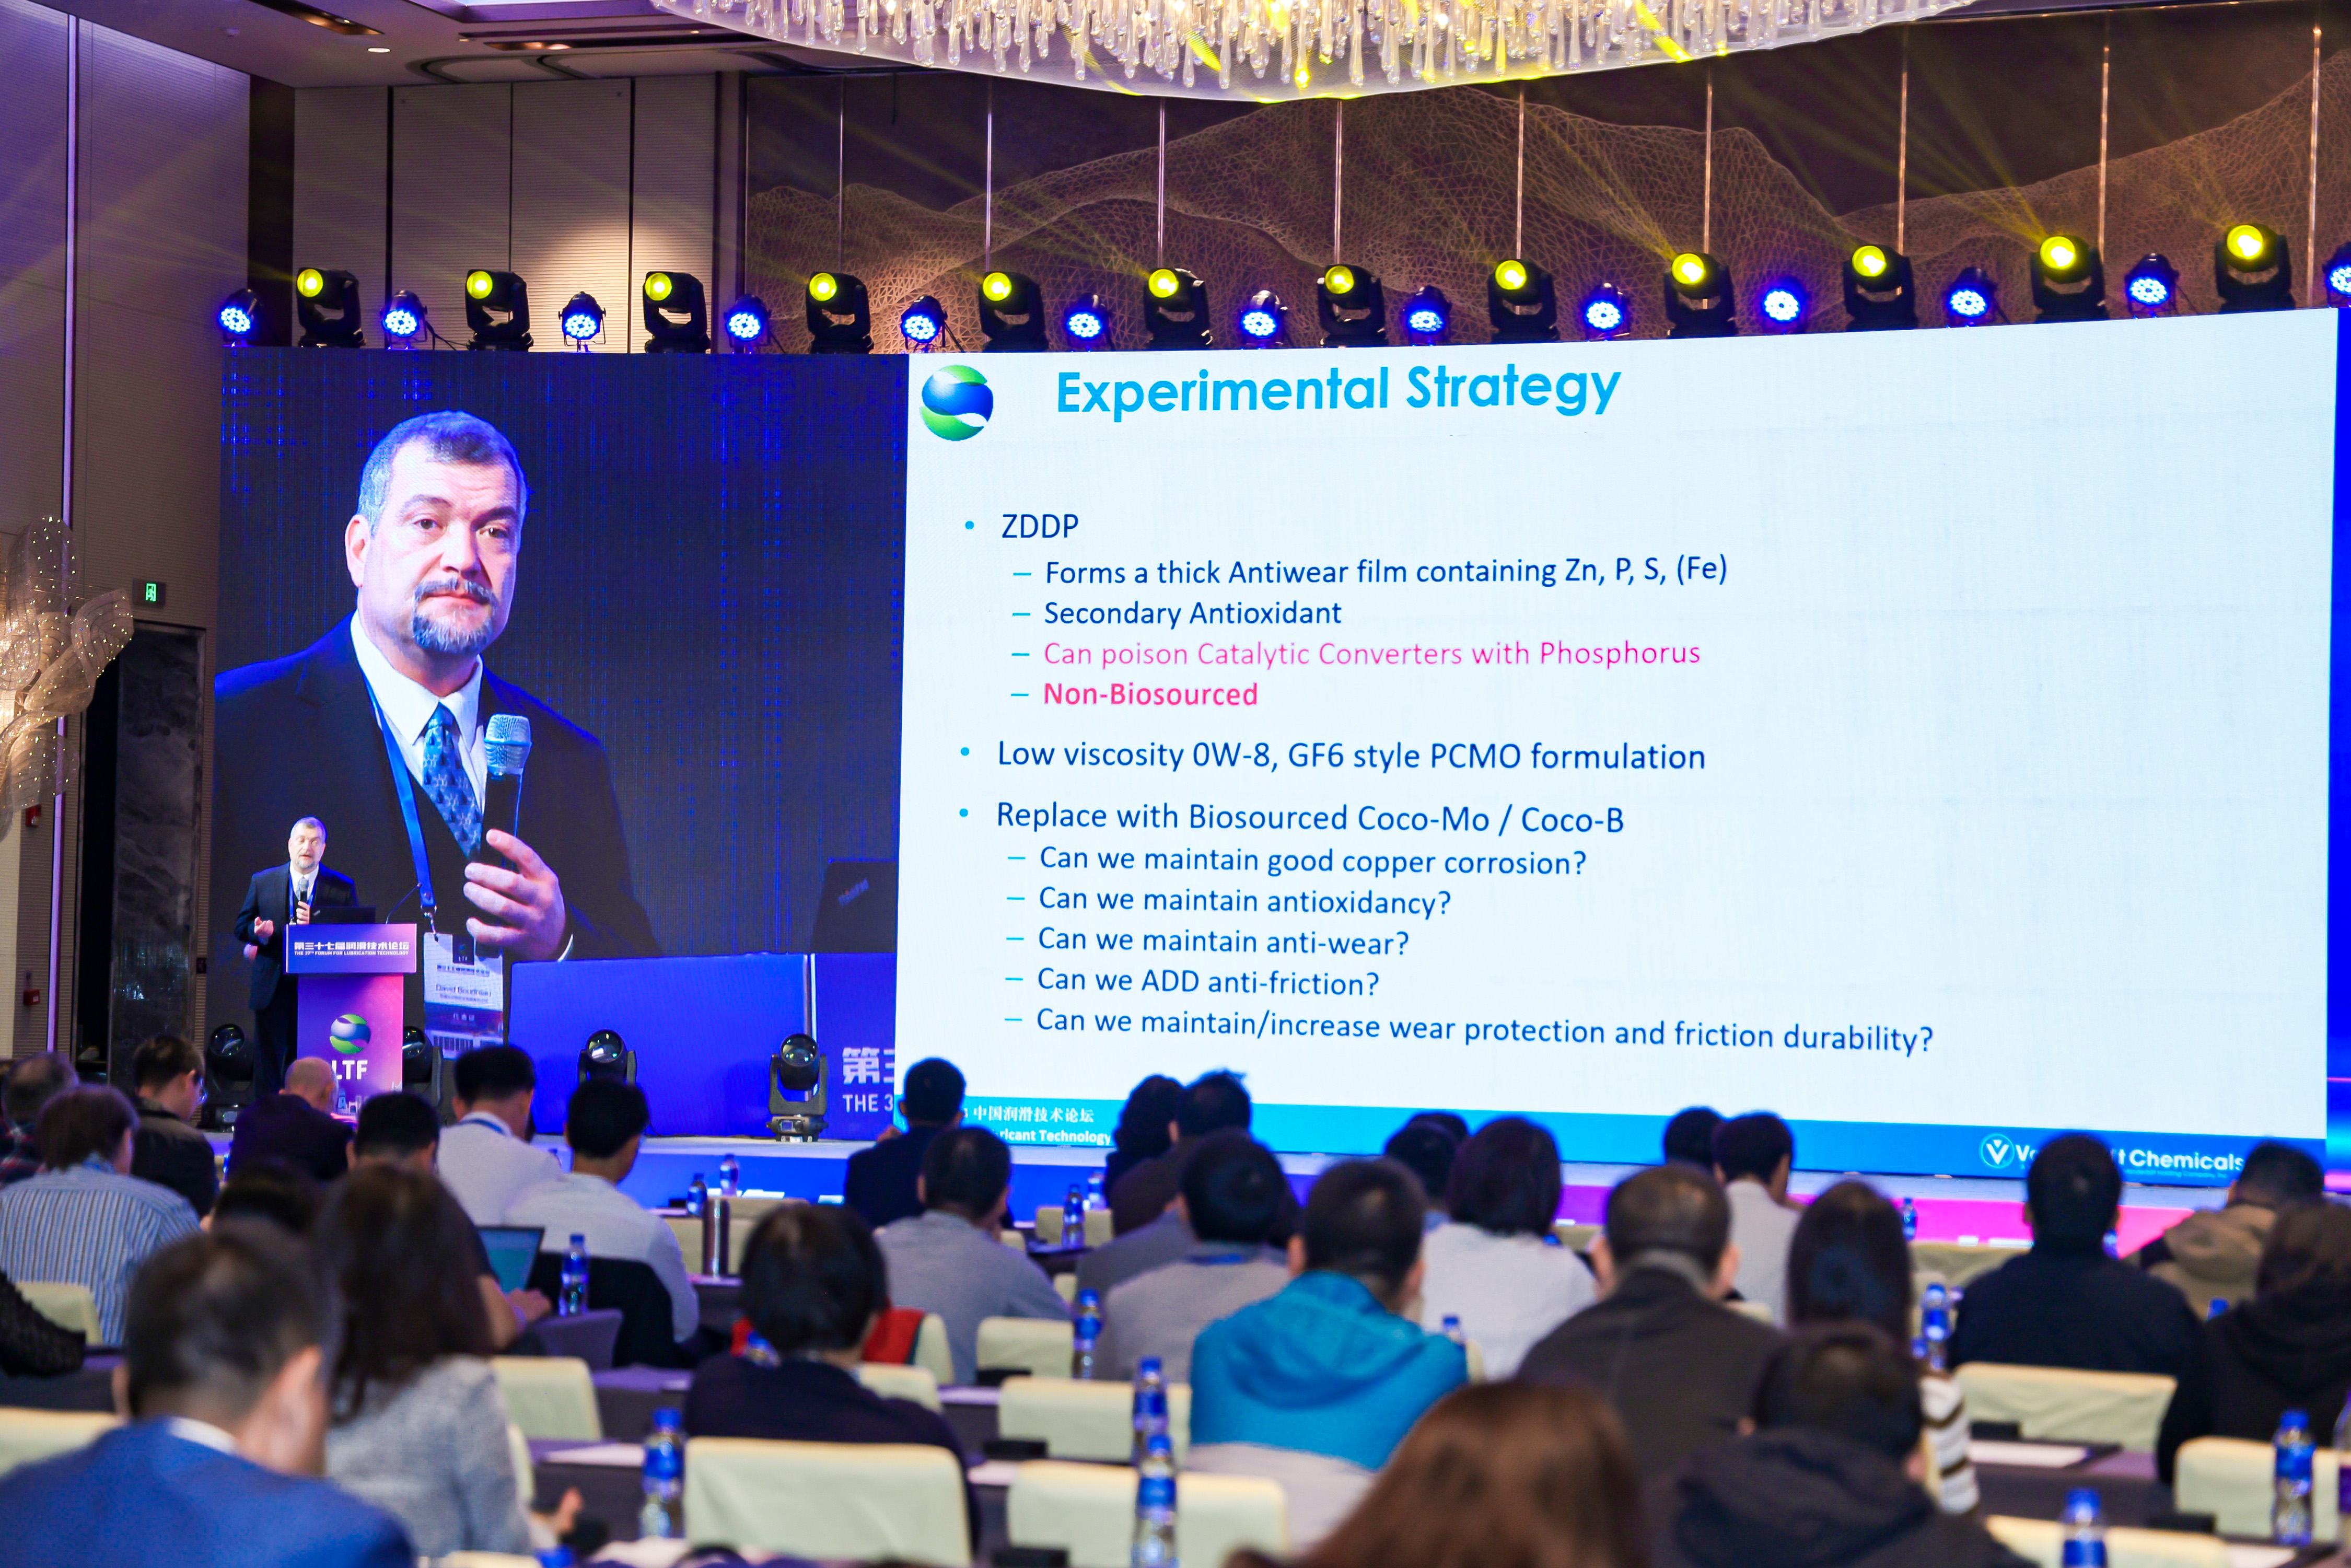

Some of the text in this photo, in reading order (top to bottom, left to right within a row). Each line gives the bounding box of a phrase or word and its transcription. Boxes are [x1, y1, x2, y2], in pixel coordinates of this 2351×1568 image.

[1058, 364, 1622, 423] Experimental Strategy
[1002, 514, 1078, 538] ZDDP
[1047, 553, 1727, 587] Forms a thick Antiwear film containing Zn, P, S, (Fe)
[1045, 600, 1342, 630] Secondary Antioxidant
[1045, 640, 1701, 670] Can poison Catalytic Converters with Phosphorus
[1045, 682, 1257, 705] Non-Biosourced
[999, 740, 1705, 773] Low viscosity 0W-8, GF6 style PCMO formulation
[998, 801, 1623, 837] Replace with Biosourced Coco-Mo / Coco-B
[1041, 846, 1586, 878] Can we maintain good copper corrosion?
[1040, 887, 1451, 920] Can we maintain antioxidancy?
[294, 942, 410, 950] 第三十七届润滑技术论坛
[1039, 927, 1409, 955] Can we maintain anti-wear?
[1038, 967, 1379, 996] Can we ADD anti-friction?
[1038, 1008, 1933, 1058] Can we maintain/increase wear protection and friction durability?
[332, 1060, 368, 1080] LTF
[842, 1094, 879, 1112] THE
[973, 1105, 1095, 1123] 中国润滑技术论坛
[997, 1128, 1111, 1146] ricant Technology
[2129, 1149, 2244, 1171] Chemicals
